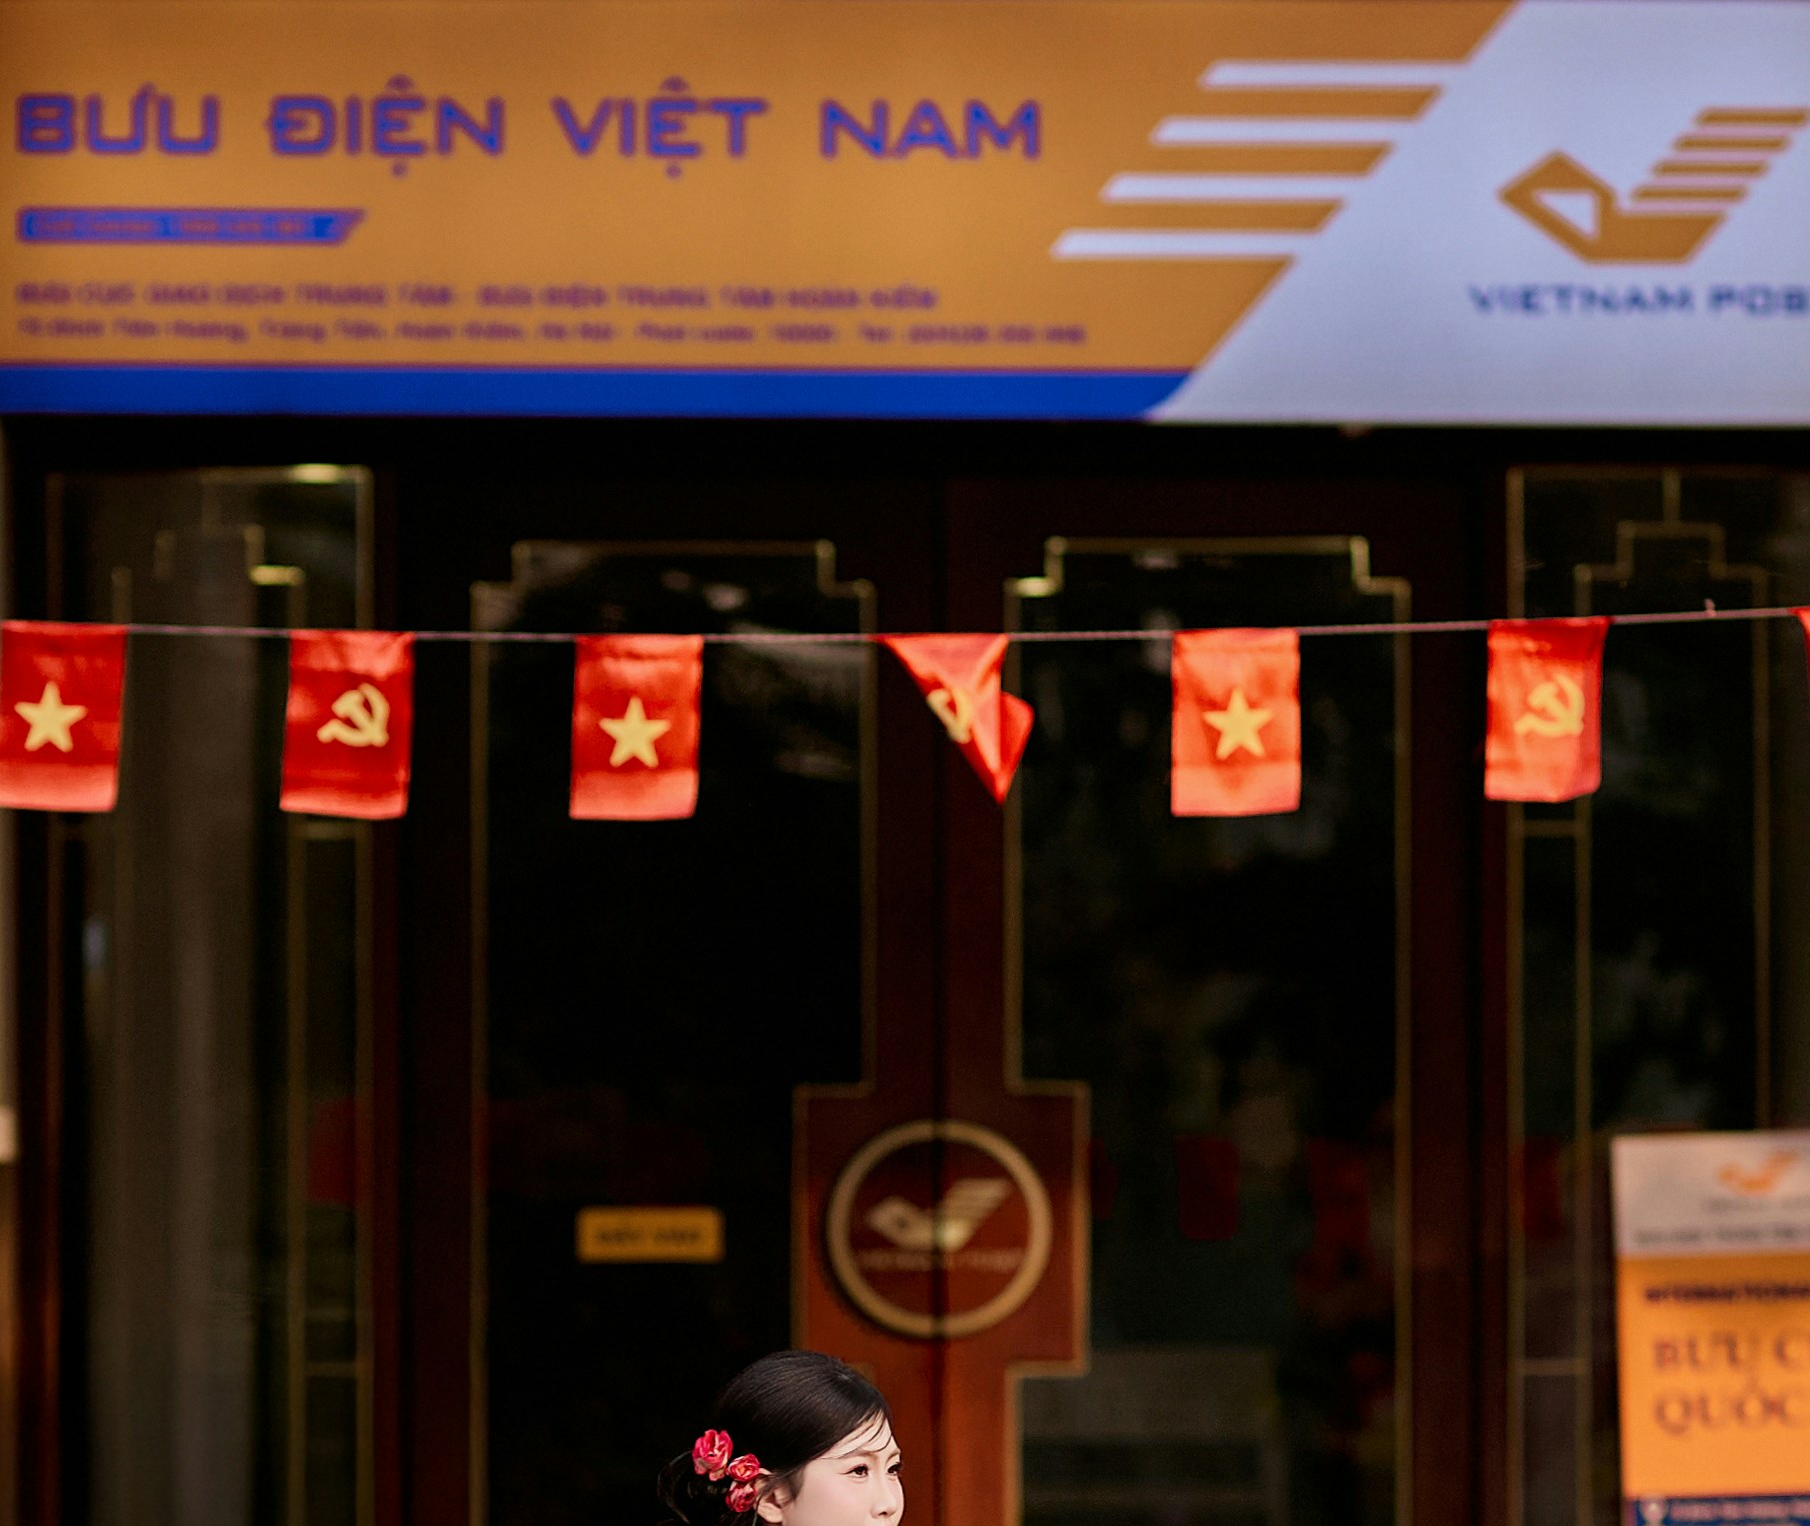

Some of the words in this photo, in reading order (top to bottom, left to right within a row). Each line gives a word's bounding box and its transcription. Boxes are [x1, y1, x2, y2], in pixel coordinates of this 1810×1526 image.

[16, 82, 220, 154] BƯU
[265, 74, 505, 178] ĐIỆN
[551, 76, 768, 179] VIỆT
[820, 98, 1040, 159] NAM
[1468, 285, 1691, 316] VIETNAM
